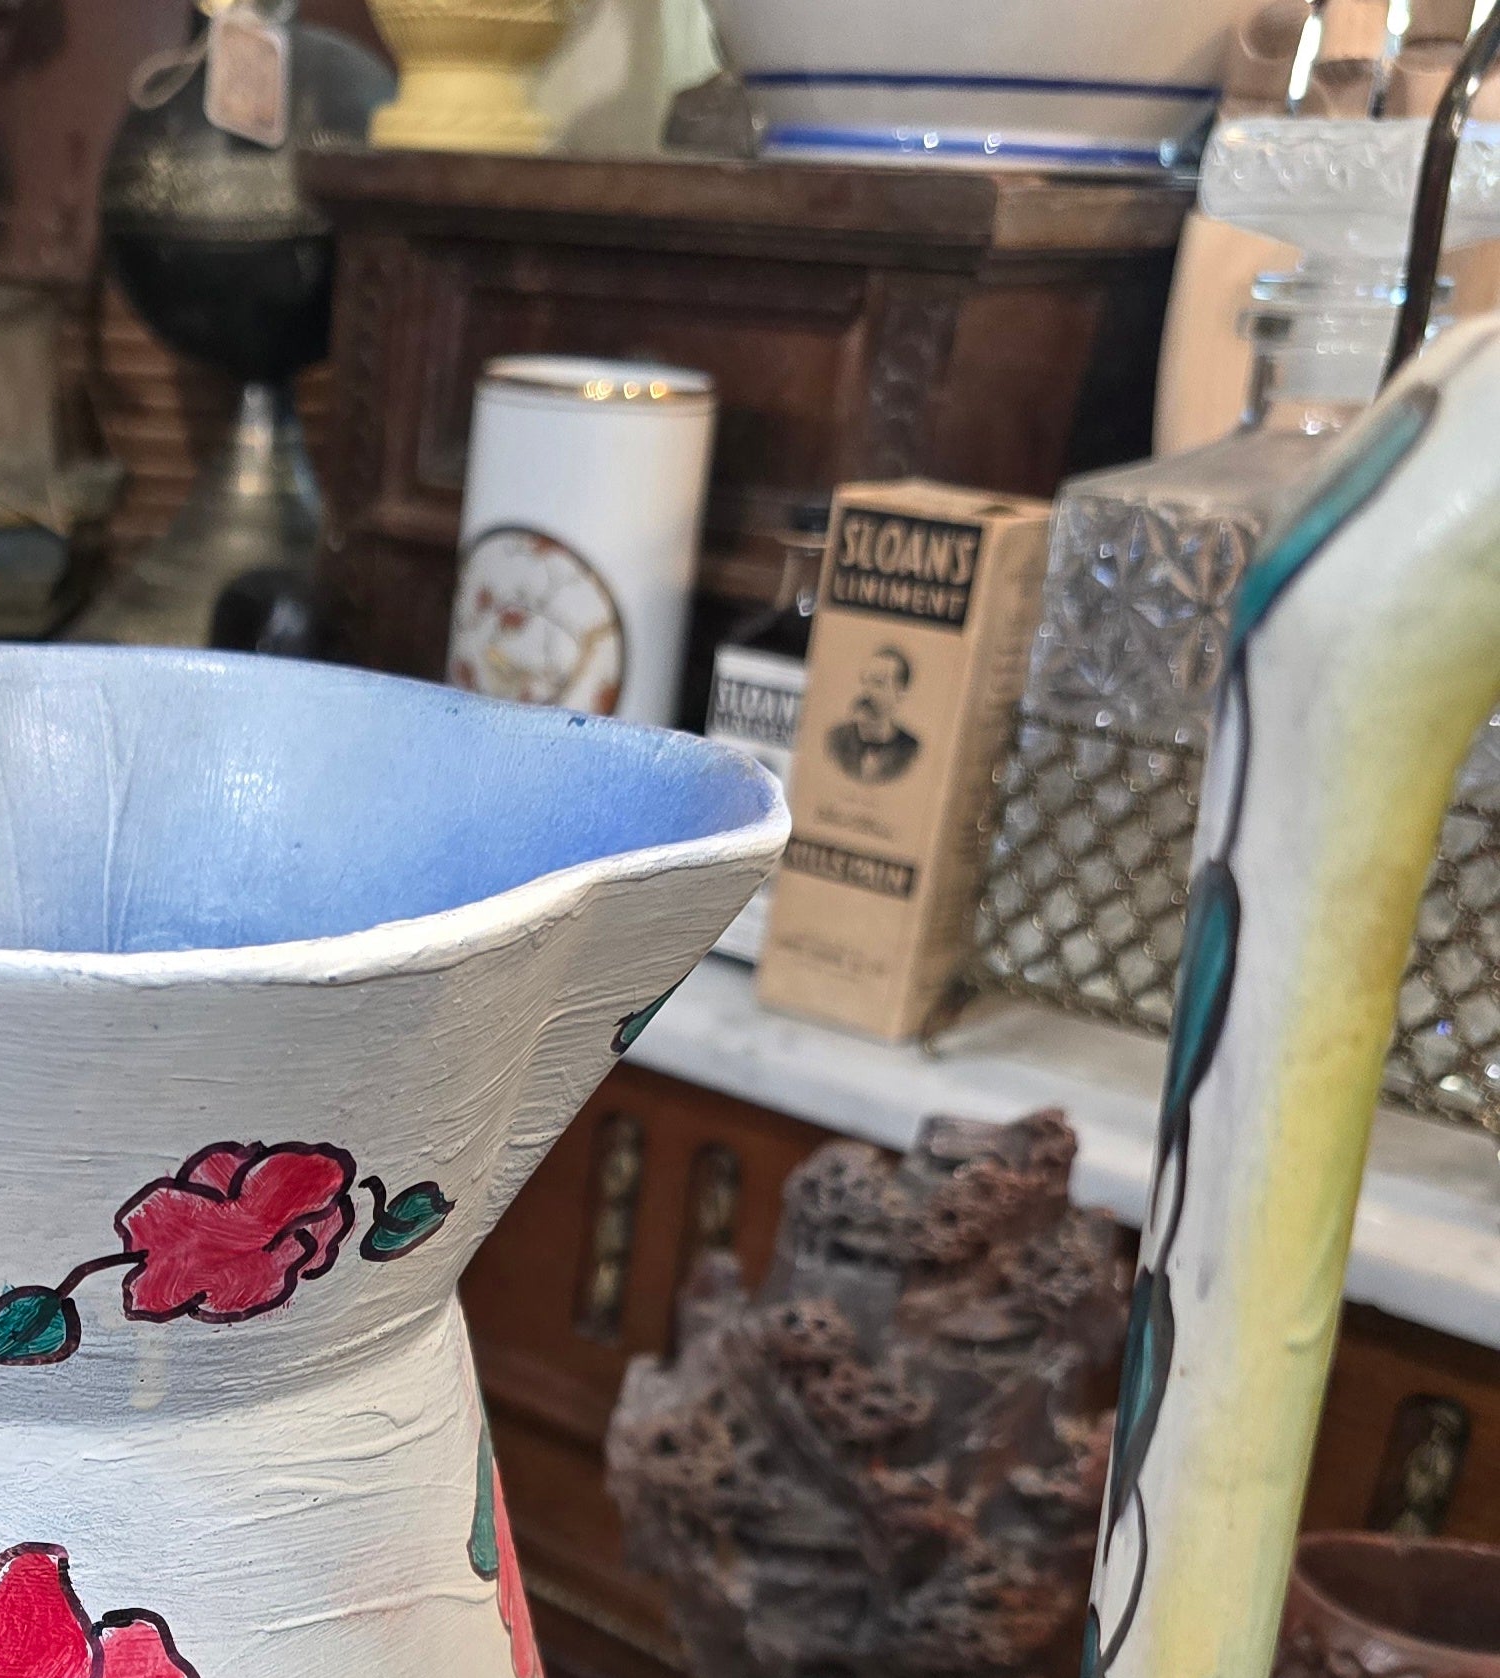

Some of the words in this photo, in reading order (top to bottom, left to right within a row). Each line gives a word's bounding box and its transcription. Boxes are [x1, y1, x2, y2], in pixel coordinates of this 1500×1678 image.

[838, 516, 976, 586] SLOAN'S
[832, 570, 966, 621] LINIMENT
[715, 681, 797, 723] SLOAN
